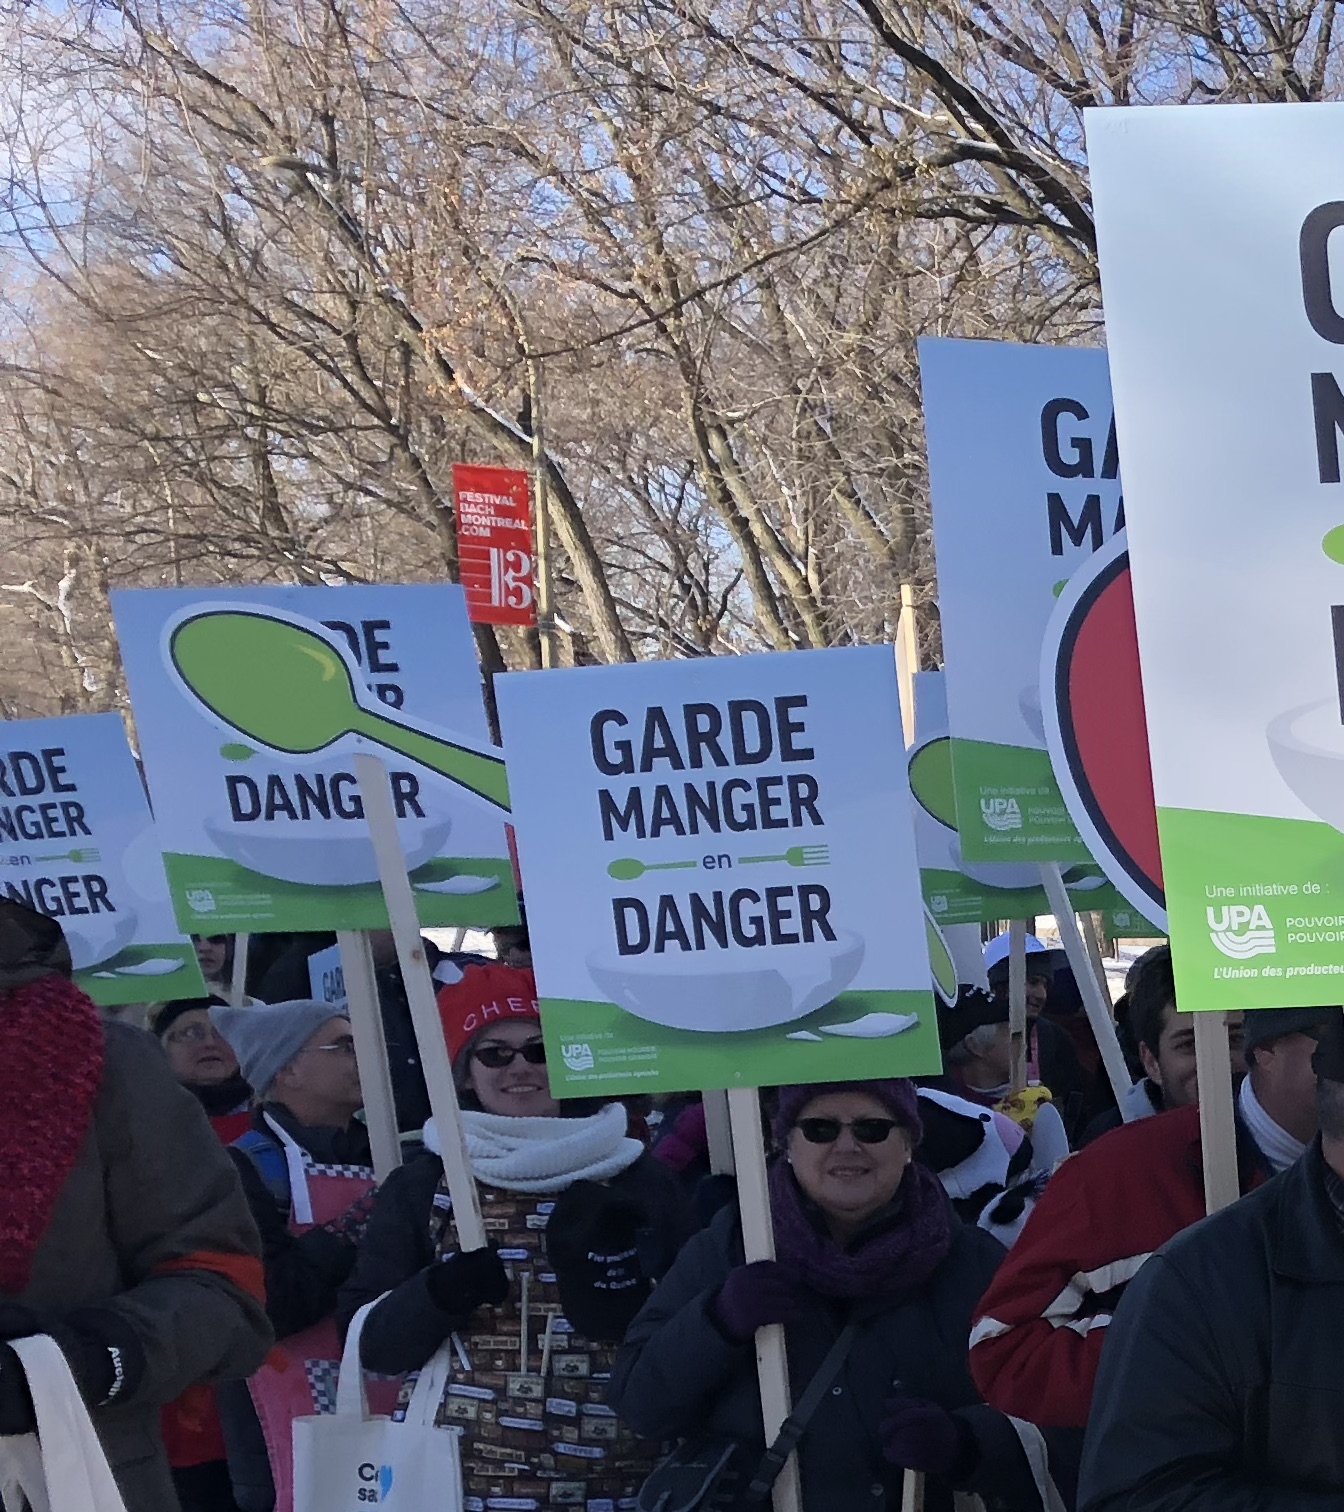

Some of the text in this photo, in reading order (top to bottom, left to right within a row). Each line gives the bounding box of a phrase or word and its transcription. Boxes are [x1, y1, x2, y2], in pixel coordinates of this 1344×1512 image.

[458, 491, 517, 507] FESTIVAL
[459, 502, 495, 515] BACH
[460, 514, 529, 531] MONTREAL
[590, 694, 815, 776] GARDE
[225, 771, 426, 822] DANGR
[597, 773, 825, 842] MANGER
[980, 798, 1021, 814] UPA
[0, 801, 93, 843] NGER
[10, 853, 33, 866] en
[702, 853, 732, 870] en
[1205, 884, 1235, 898] Une
[1239, 882, 1298, 897] initiative
[1302, 881, 1321, 894] de
[612, 884, 838, 956] DANGER
[1206, 904, 1274, 932] UPA
[1213, 966, 1258, 979] L'Union
[1261, 965, 1283, 977] des
[561, 1043, 592, 1058] UPA
